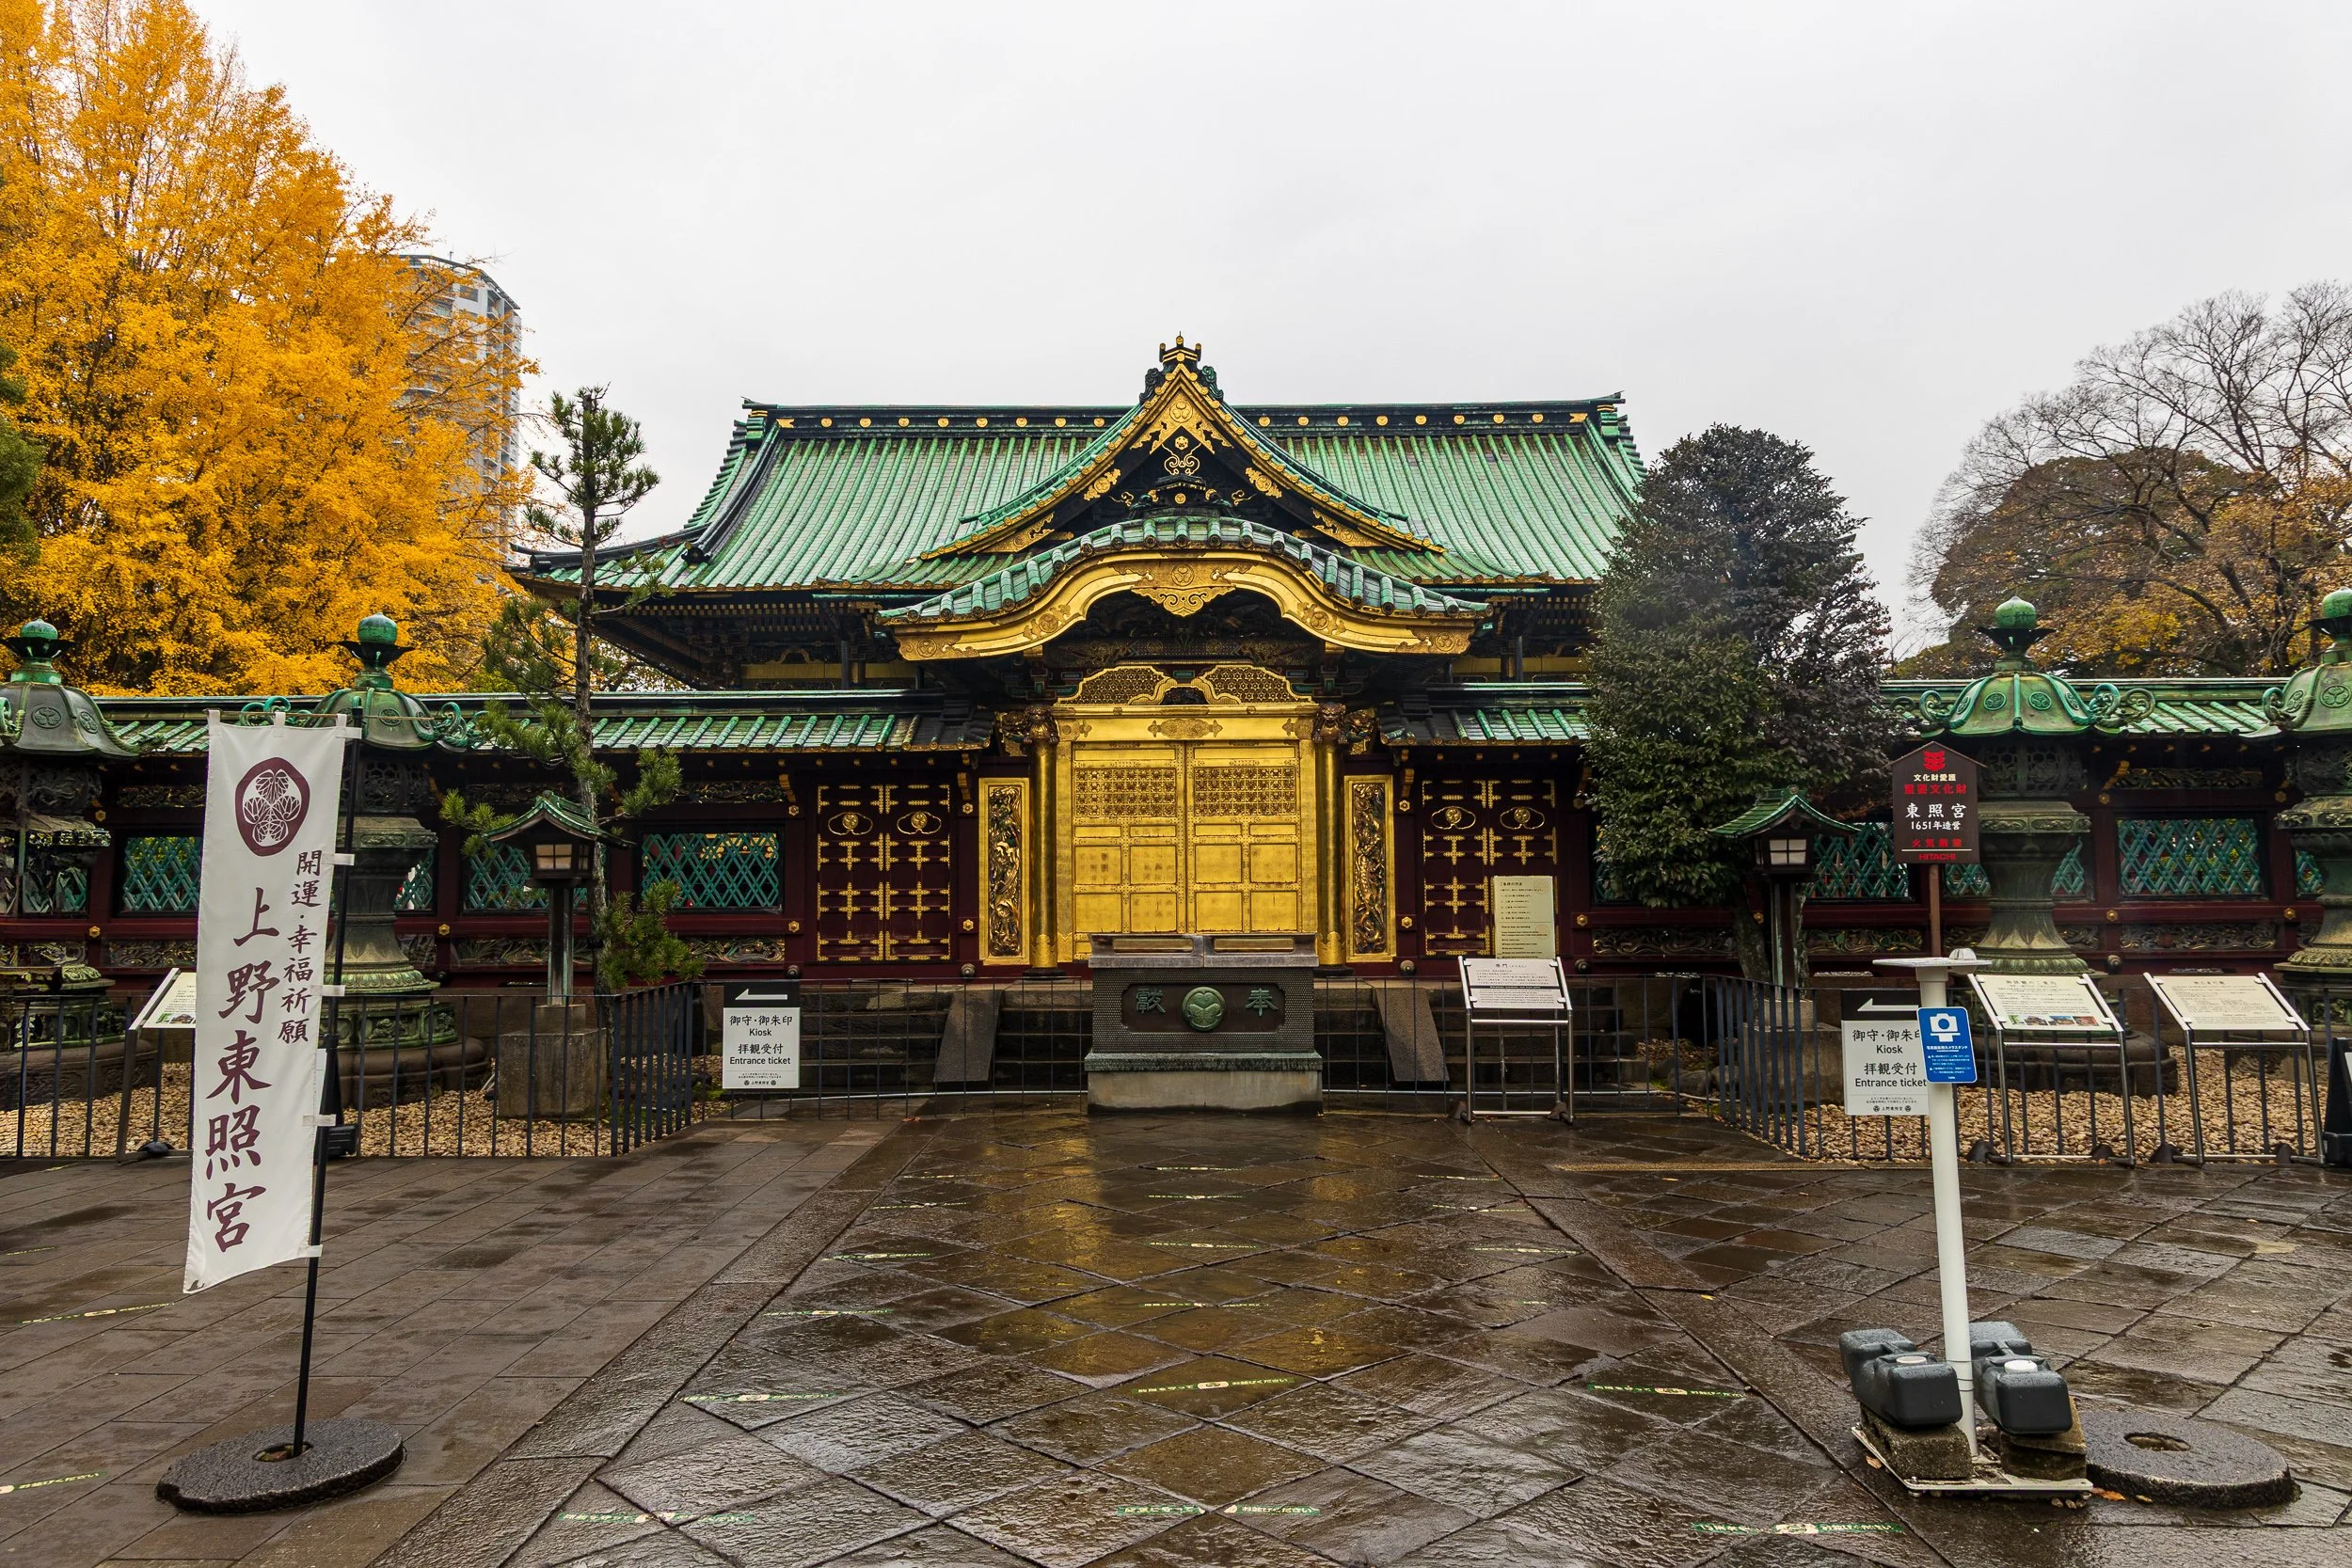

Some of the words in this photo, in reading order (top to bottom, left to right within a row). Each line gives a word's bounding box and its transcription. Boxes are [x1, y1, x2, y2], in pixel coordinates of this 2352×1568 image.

[1905, 802, 1966, 818] 東照宮
[1911, 820, 1962, 831] 1651年造営
[729, 1015, 793, 1026] 御守・御朱印
[749, 1028, 772, 1037] Kiosk
[738, 1043, 784, 1054] 拝観受付
[1876, 1045, 1903, 1054] Kiosk
[729, 1056, 766, 1065] Entrance
[768, 1056, 791, 1065] ticket
[205, 887, 279, 1253] 上野東照宮
[1864, 1062, 1918, 1075] 拝観受付
[1855, 1078, 1898, 1087] Entrance
[1899, 1078, 1927, 1087] ticket
